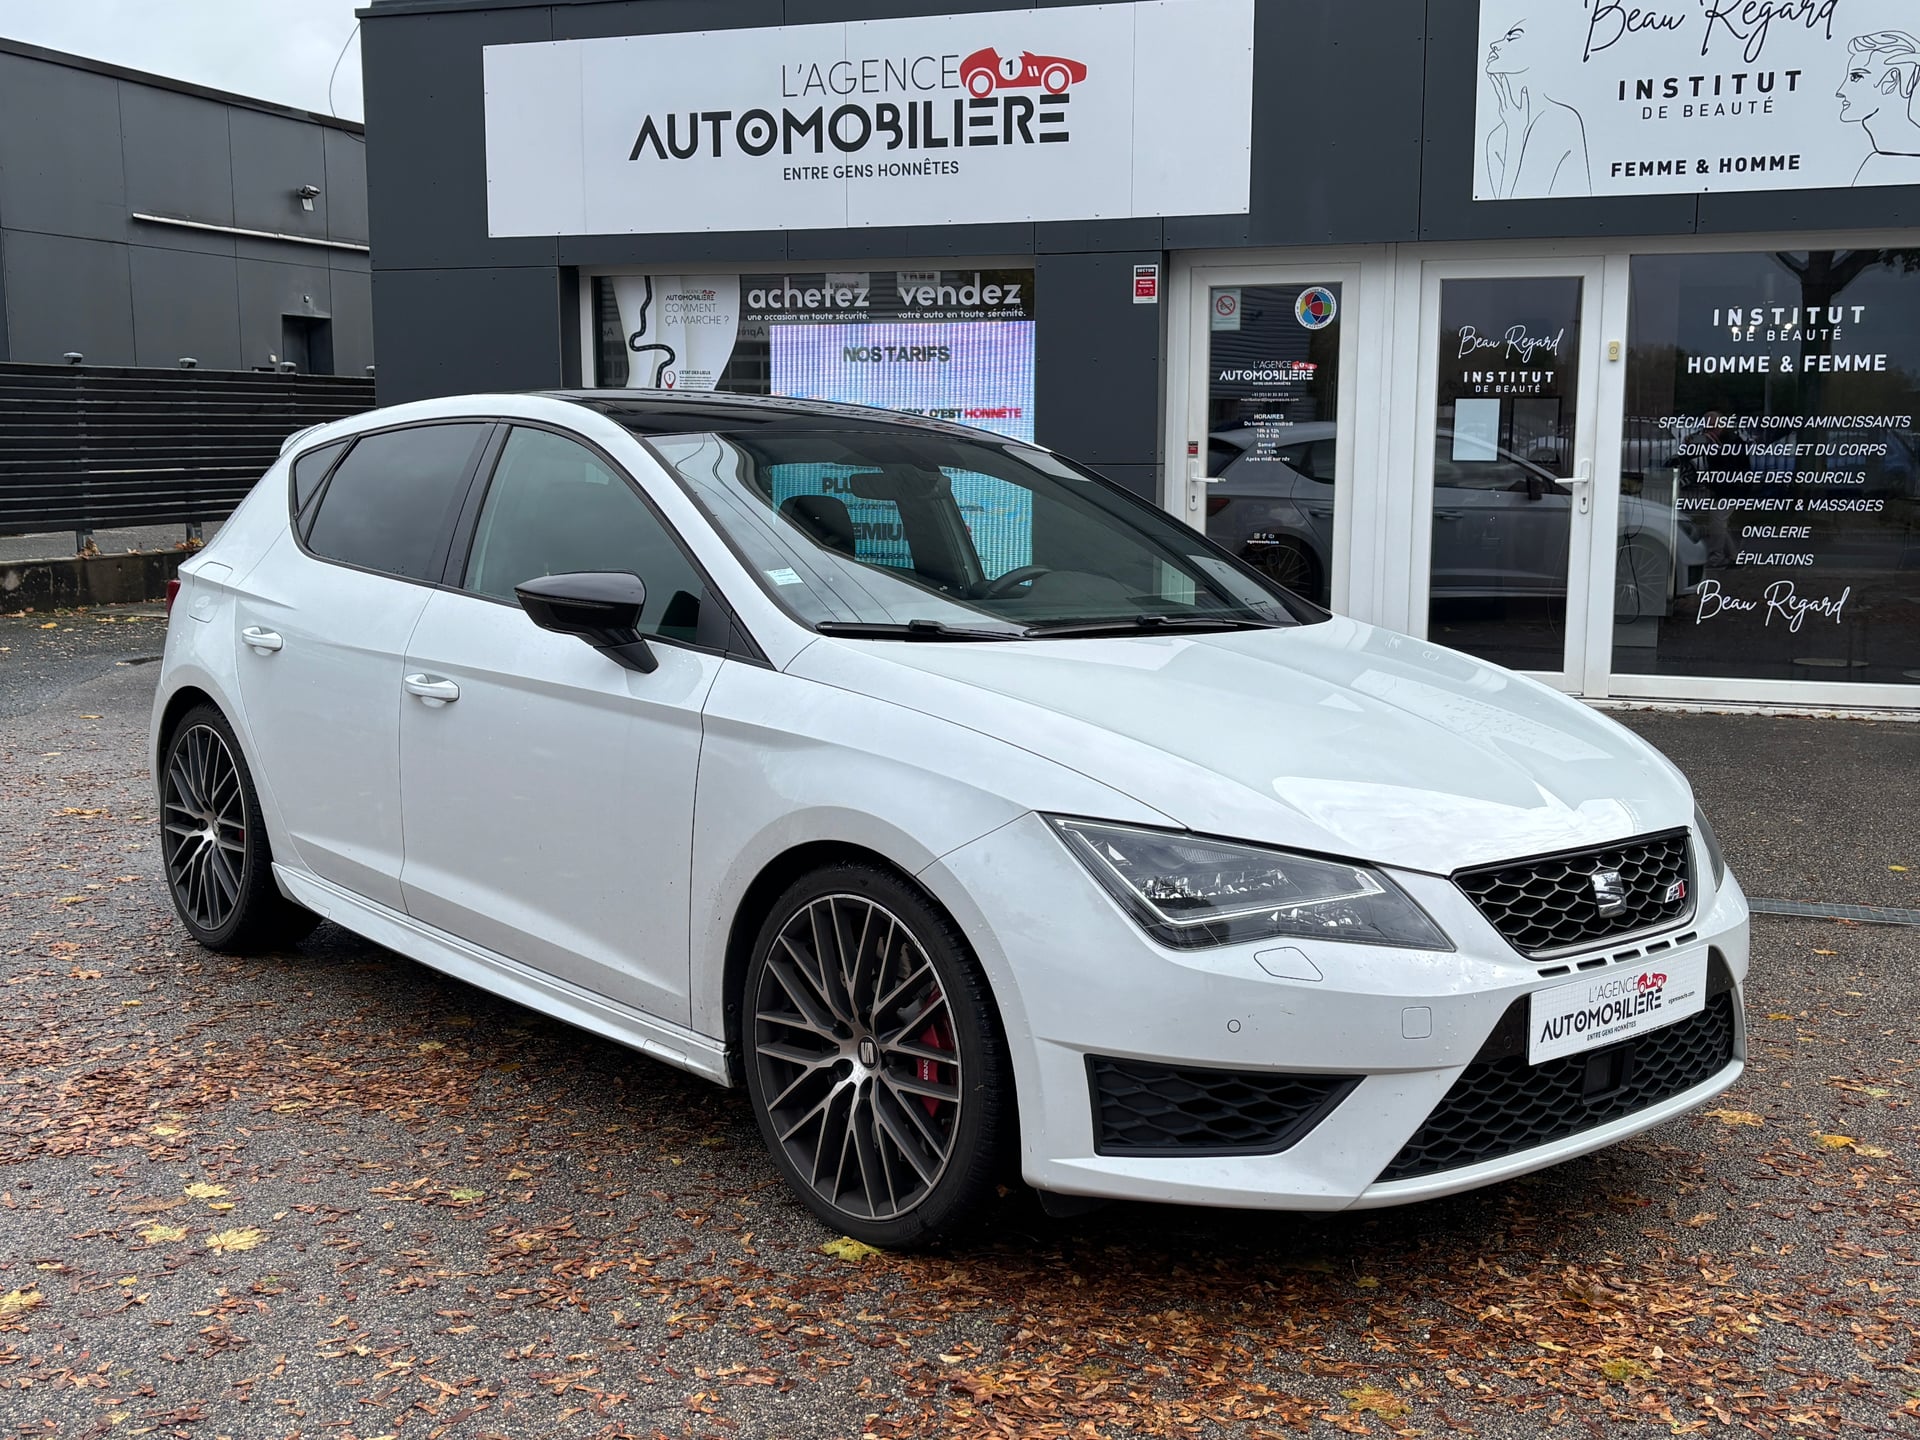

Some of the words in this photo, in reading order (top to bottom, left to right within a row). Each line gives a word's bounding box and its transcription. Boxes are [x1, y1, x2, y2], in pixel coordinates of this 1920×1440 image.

[782, 54, 960, 98] L'AGENCE
[1618, 70, 1803, 101] INSTITUT
[1642, 106, 1669, 120] DE
[1683, 97, 1774, 118] BEAUTÉ
[782, 166, 829, 180] ENTRE
[832, 164, 874, 179] GENS
[878, 158, 960, 177] HONNÊTES
[1611, 159, 1687, 177] FEMME
[1696, 158, 1710, 175] &
[1719, 154, 1800, 174] HOMME
[748, 277, 870, 308] achetez
[898, 272, 1022, 306] vendez
[665, 303, 717, 313] COMMENT
[764, 312, 797, 320] occasion
[836, 311, 870, 320] sécurité.
[961, 310, 984, 318] toute
[987, 308, 1026, 317] sérénité.
[1712, 306, 1867, 326] INSTITUT
[665, 315, 678, 326] ÇA
[680, 315, 721, 324] MARCHE
[724, 316, 729, 324] ?
[1732, 329, 1755, 342] DE
[1767, 326, 1842, 342] BEAUTÉ
[1457, 325, 1500, 359] Beau
[1505, 325, 1564, 364] Regard
[843, 346, 883, 362] NOS
[885, 345, 950, 362] TARIFS
[1253, 360, 1291, 368] L'AGENCE
[1687, 355, 1770, 374] HOMME
[1779, 356, 1794, 373] &
[1803, 354, 1887, 372] FEMME
[1463, 370, 1555, 383] INSTITUT
[1475, 385, 1490, 394] DE
[1495, 383, 1541, 393] BEAUTÉ
[1658, 413, 1737, 430] SPÉCIALISÉ
[1738, 416, 1758, 429] EN
[1760, 415, 1802, 429] SOINS
[1804, 415, 1911, 429] AMINCISSANTS
[1677, 443, 1718, 456] SOINS
[1721, 443, 1742, 456] DU
[1744, 443, 1793, 456] VISAGE
[1795, 443, 1811, 456] ET
[1813, 443, 1835, 456] DU
[1837, 442, 1887, 456] CORPS
[1695, 471, 1762, 484] TATOUAGE
[1763, 470, 1792, 484] DES
[1794, 470, 1866, 484] SOURCILS
[1674, 498, 1792, 512] ENVELOPPEMENT
[1794, 499, 1804, 512] &
[1807, 498, 1884, 512] MASSAGES
[1741, 525, 1812, 539] ONGLERIE
[1735, 550, 1814, 567] ÉPILATIONS
[1696, 579, 1757, 625] Beau
[1764, 580, 1851, 633] Regard
[1588, 975, 1638, 1003] L'AGENCE
